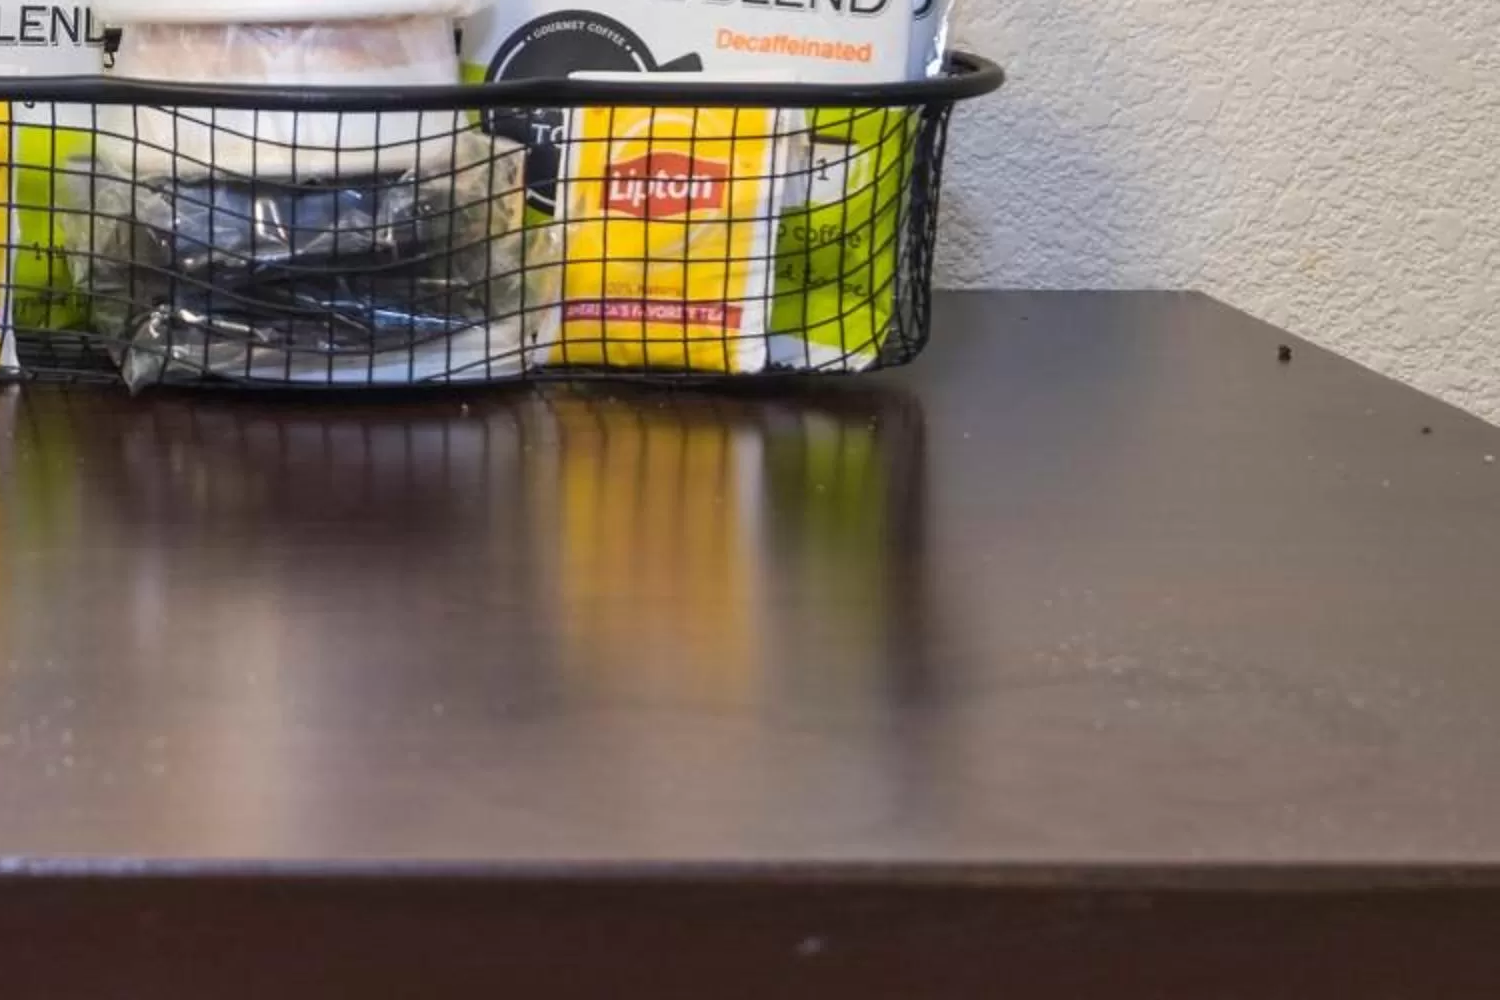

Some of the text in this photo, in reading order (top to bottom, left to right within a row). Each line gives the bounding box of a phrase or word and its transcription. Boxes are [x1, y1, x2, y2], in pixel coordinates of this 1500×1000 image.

[532, 19, 627, 47] GOURMET COFFEE
[715, 27, 874, 63] Decaffeinated
[609, 168, 713, 208] Lipton
[793, 223, 862, 249] coffe
